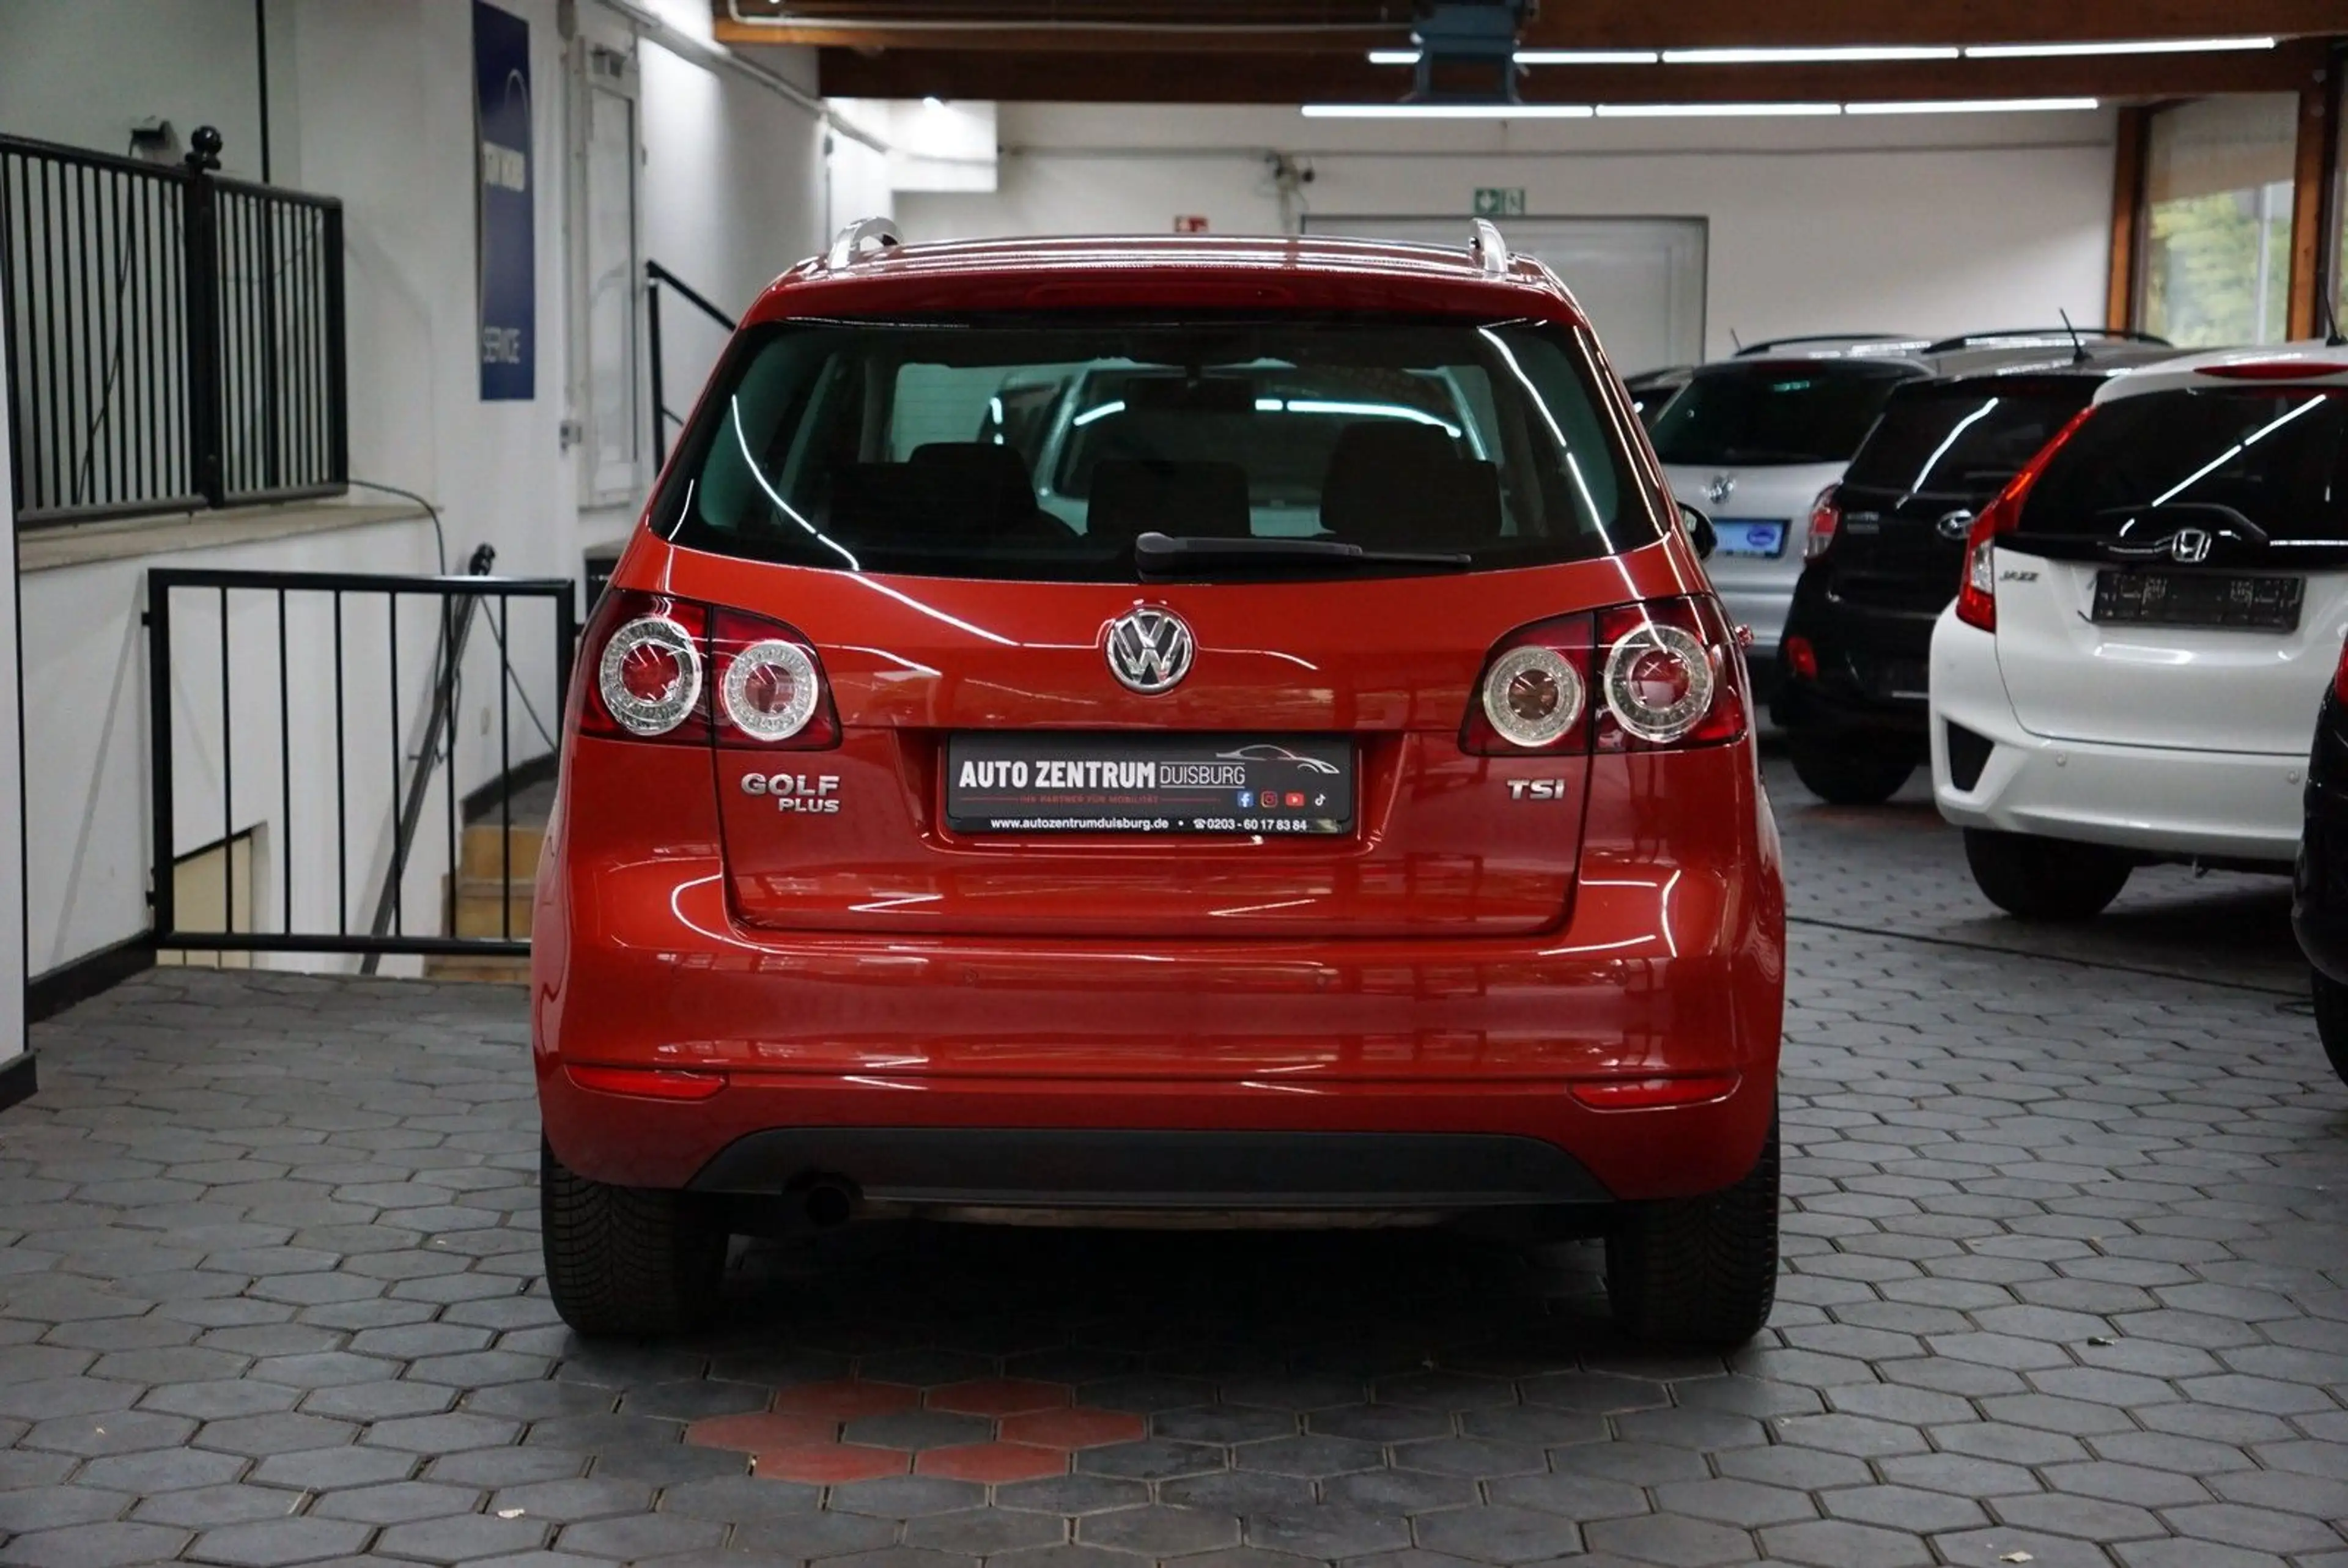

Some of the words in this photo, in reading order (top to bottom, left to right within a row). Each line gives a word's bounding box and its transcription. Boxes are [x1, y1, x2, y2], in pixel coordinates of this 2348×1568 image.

[1998, 569, 2039, 583] JAZZ
[959, 761, 1028, 788] AUTO
[1035, 761, 1156, 788] ZENTRUM
[1161, 765, 1246, 784] DUISBURG
[740, 772, 840, 796] GOLF
[1507, 779, 1565, 800] TSI
[778, 798, 840, 812] PLUS
[990, 817, 1169, 831] www.autozentrumduisburg.de
[1206, 819, 1236, 830] 0203
[1244, 819, 1258, 830] 60
[1261, 819, 1274, 830] 17
[1276, 819, 1291, 830] 83
[1293, 820, 1307, 831] 84
